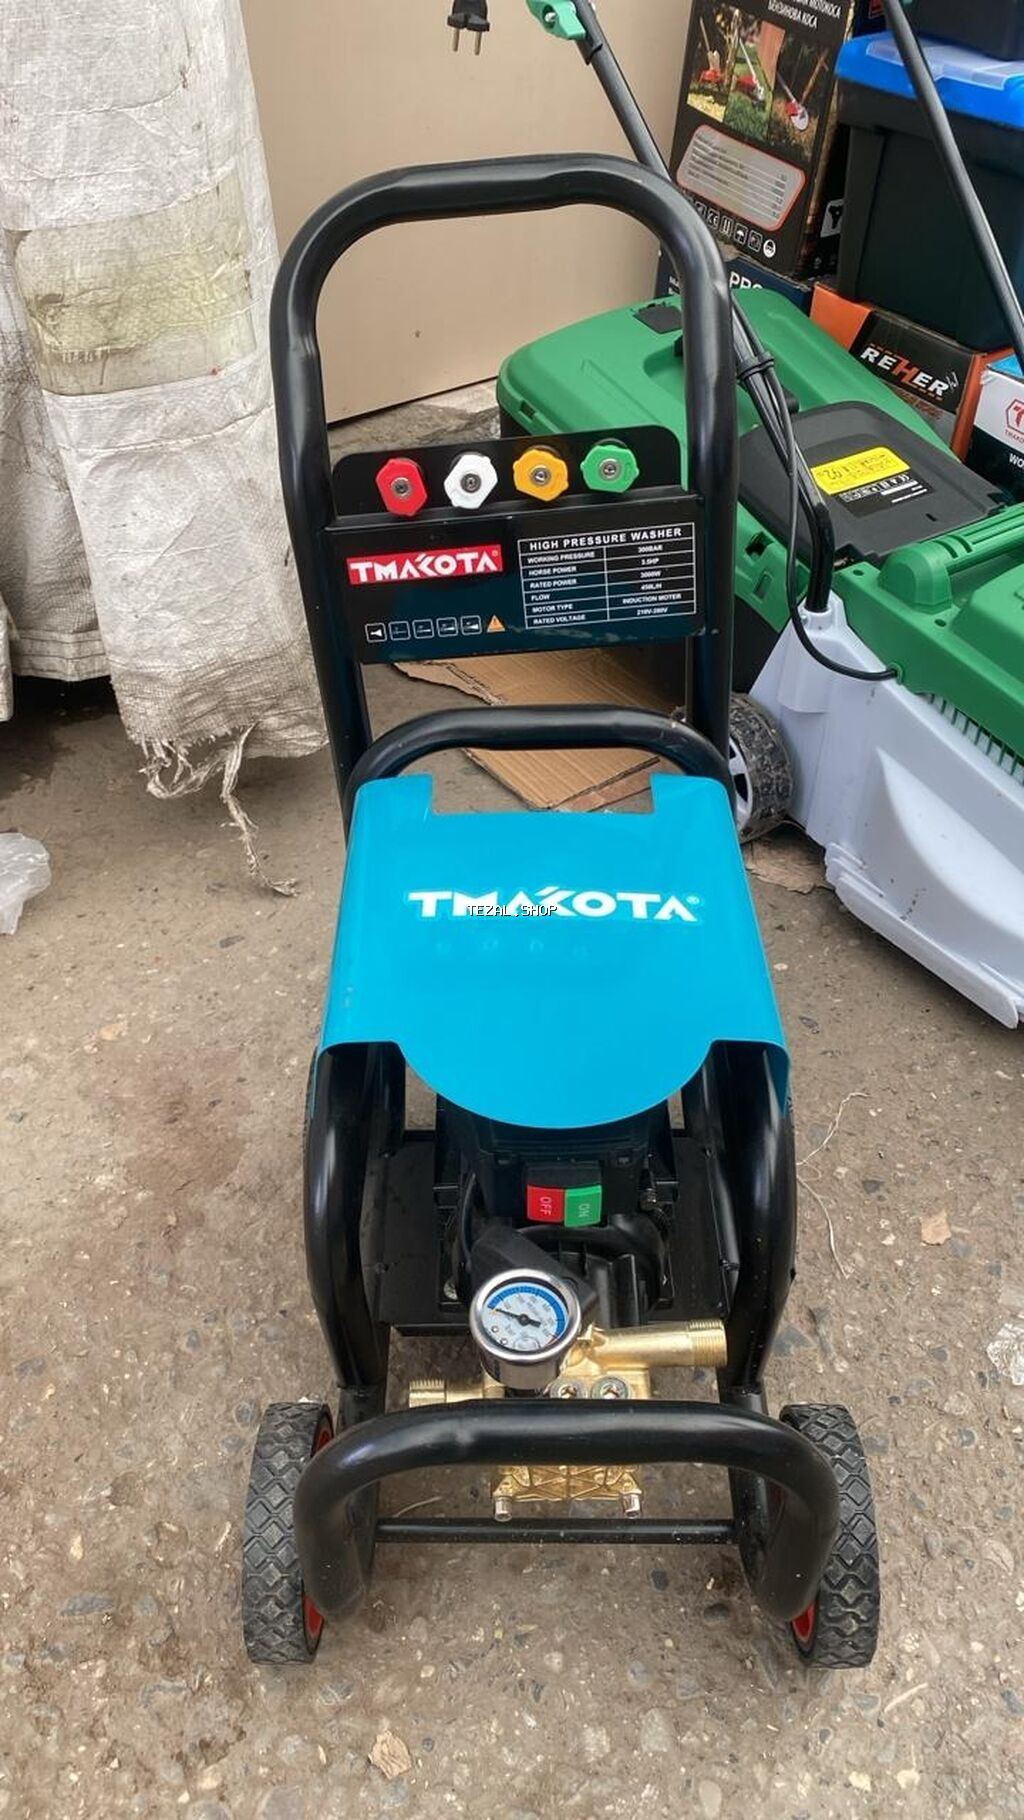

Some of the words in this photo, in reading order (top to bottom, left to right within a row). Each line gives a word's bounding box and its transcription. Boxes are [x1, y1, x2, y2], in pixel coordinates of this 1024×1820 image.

[860, 347, 949, 396] REHER
[529, 539, 559, 551] HIGH
[563, 533, 627, 548] PRESSURE
[631, 527, 683, 541] WASHER
[527, 554, 559, 564] WORKING
[560, 551, 596, 561] PRESSURE
[349, 550, 498, 582] TMAKOTA
[529, 567, 552, 576] HORSE
[553, 565, 577, 574] POWER
[530, 580, 552, 589] RATED
[553, 578, 577, 587] POWER
[622, 595, 657, 604] INDUCTION
[532, 605, 556, 613] MOTOR
[533, 616, 556, 625] RATED
[556, 614, 586, 623] VOLTAGE
[540, 1196, 552, 1216] OFF
[578, 1203, 590, 1218] ON
